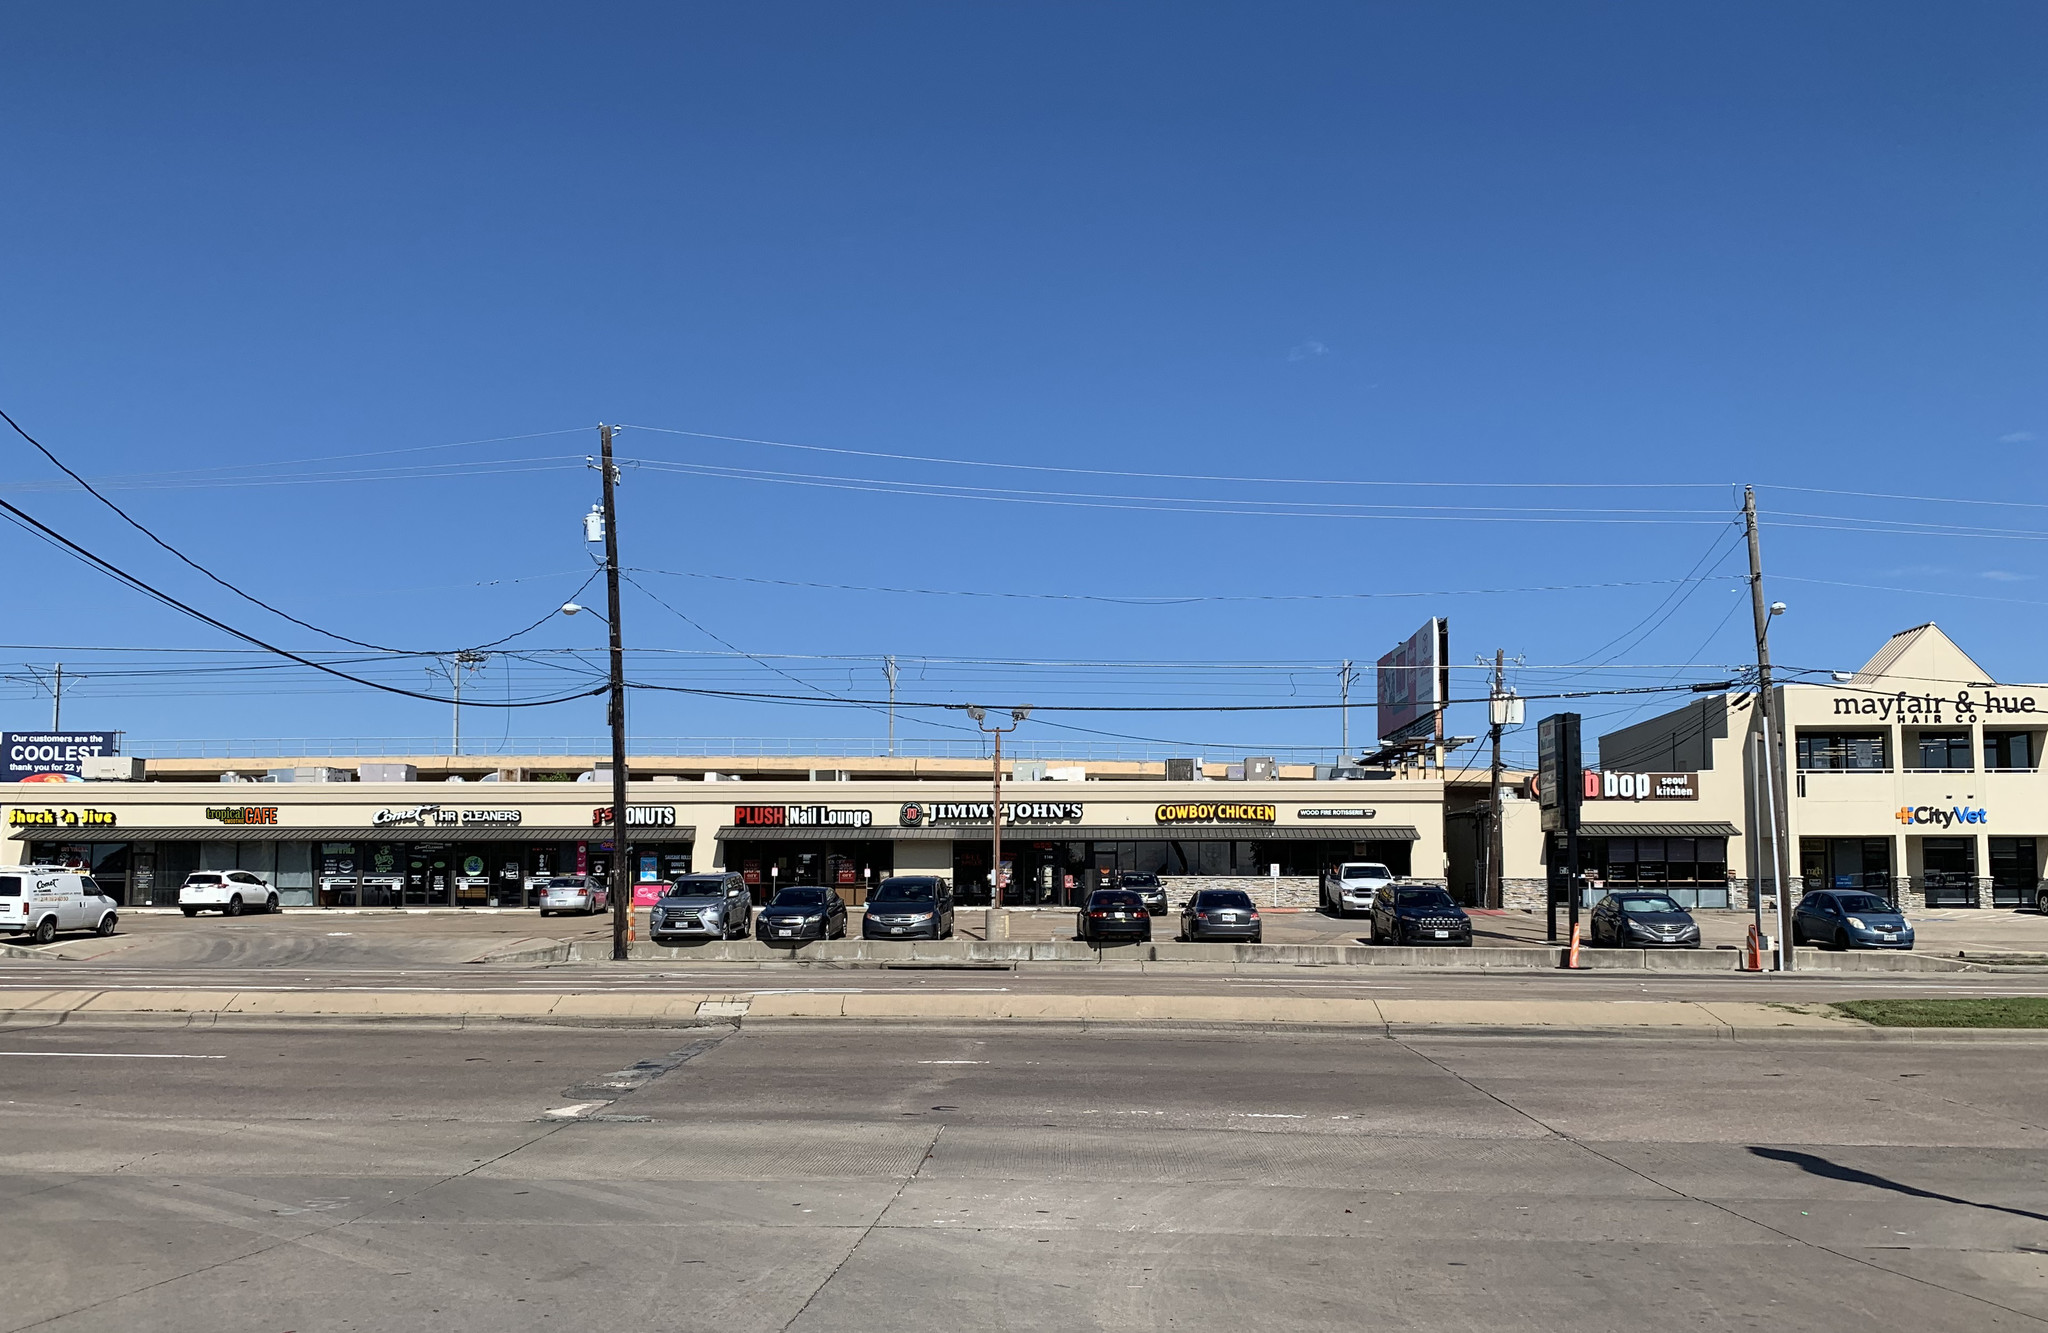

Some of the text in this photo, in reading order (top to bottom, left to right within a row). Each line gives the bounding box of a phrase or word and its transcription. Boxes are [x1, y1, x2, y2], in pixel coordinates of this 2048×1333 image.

[1834, 690, 2036, 721] mayfair & hue
[1897, 714, 1986, 724] HAIR CO.
[11, 734, 28, 743] Our
[29, 735, 73, 743] customers
[89, 735, 104, 743] the
[10, 745, 103, 762] COOLEST
[9, 763, 33, 771] thank
[34, 764, 50, 773] you
[1661, 775, 1688, 785] seoul
[1656, 786, 1693, 796] kitchen
[8, 808, 54, 824] Shuck
[81, 809, 113, 824] Jive
[206, 807, 278, 825] tropical CAFE
[373, 804, 440, 824] Comet
[460, 810, 521, 822] CLEANERS
[626, 807, 675, 825] ONUTS
[735, 806, 870, 828] PLUSH Nail Lounge
[1008, 803, 1083, 822] JOHN'S
[1157, 804, 1276, 821] COWBOY CHICKEN
[1914, 806, 1988, 829] CityVet
